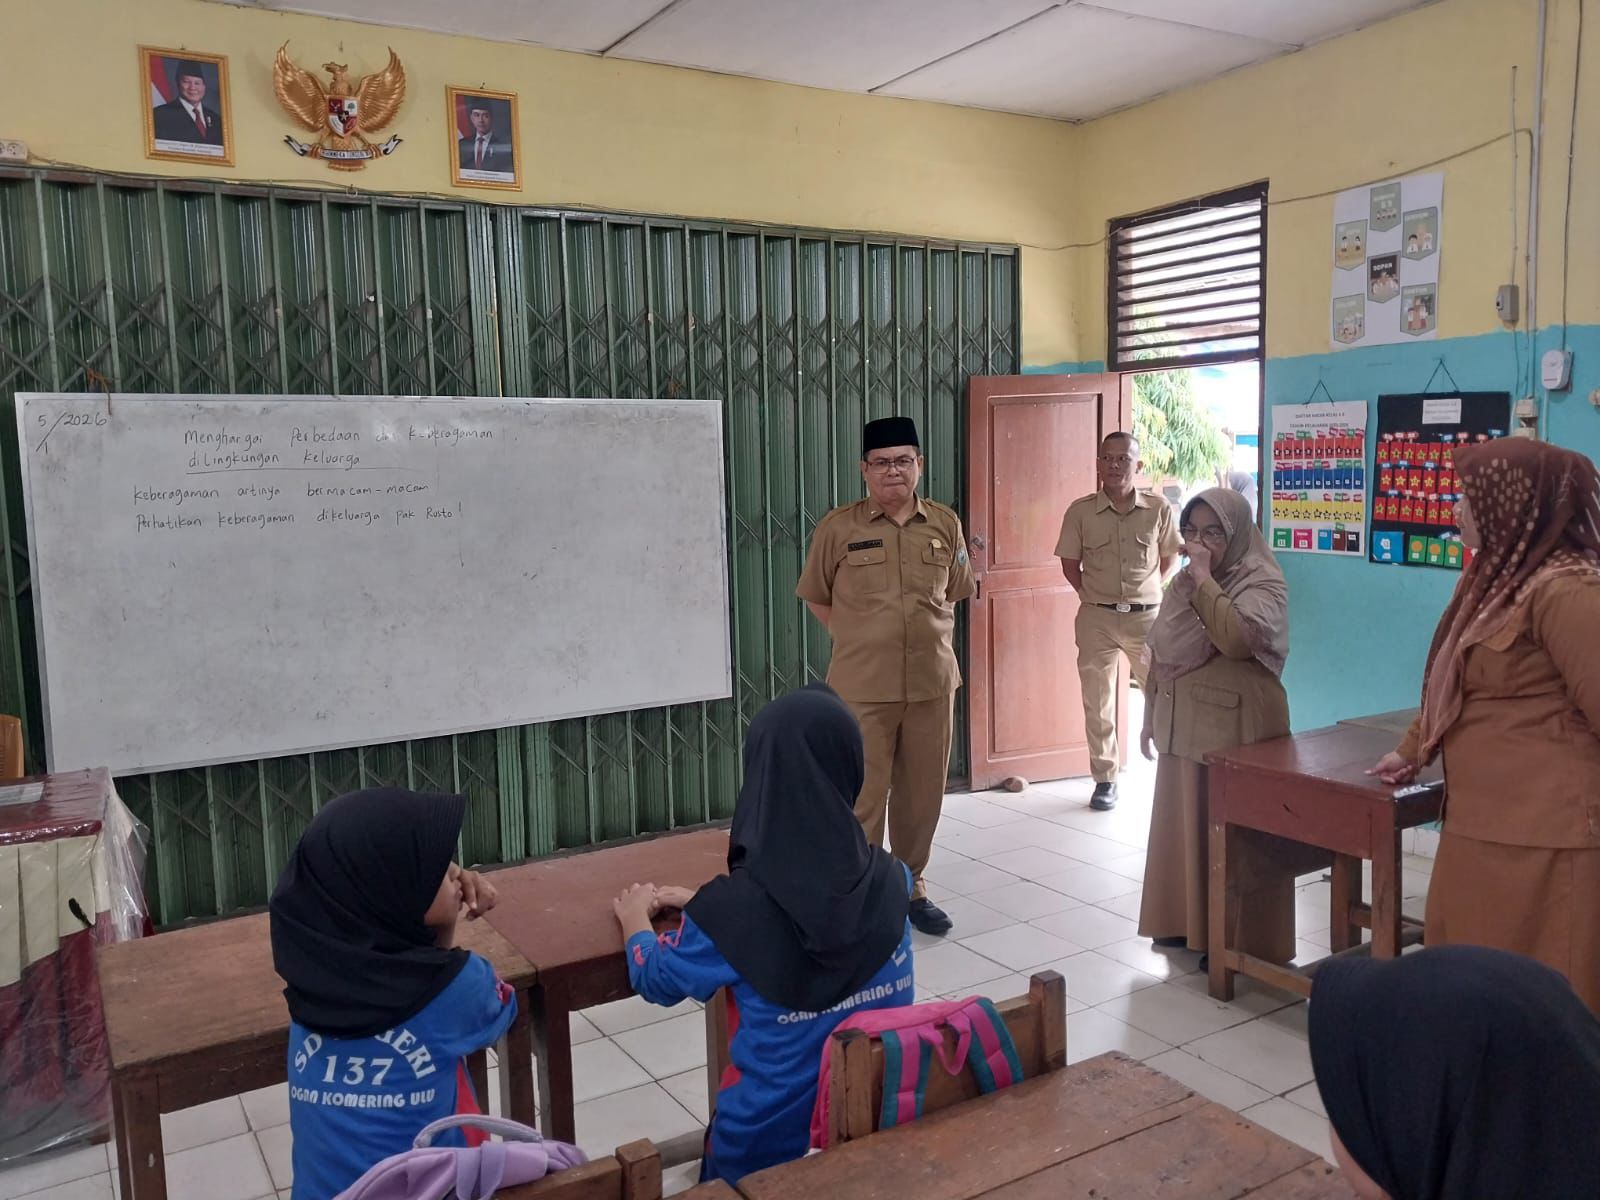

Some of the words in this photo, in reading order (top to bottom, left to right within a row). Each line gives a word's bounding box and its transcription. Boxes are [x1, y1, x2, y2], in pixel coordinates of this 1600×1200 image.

[184, 426, 264, 452] Menghargai
[290, 426, 360, 448] Perbedaan
[236, 483, 281, 501] artinya
[294, 1032, 323, 1074] SD
[321, 1054, 395, 1086] 137
[290, 1085, 319, 1104] OGAN
[321, 1091, 406, 1109] KOMERING
[410, 1088, 436, 1106] ULU
